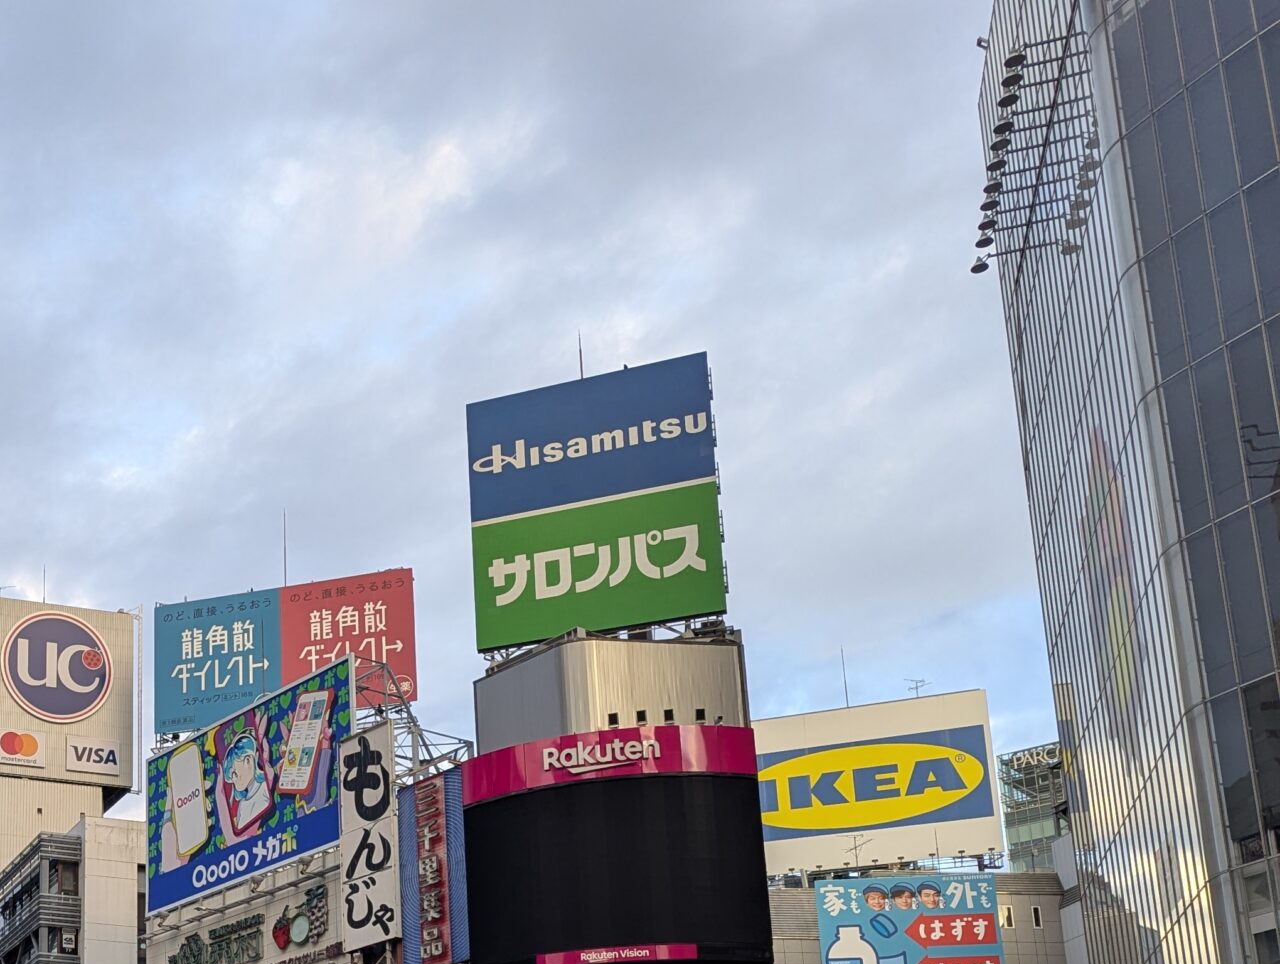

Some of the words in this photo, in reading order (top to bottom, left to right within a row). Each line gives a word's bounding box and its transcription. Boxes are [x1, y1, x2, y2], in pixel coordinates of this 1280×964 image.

[472, 411, 708, 474] Hisamitsu
[488, 523, 707, 607] サロンパス
[290, 576, 407, 604] のど、直接、うるおう
[162, 597, 272, 624] のど、直接、うるおう
[310, 601, 388, 641] 龍角散
[181, 620, 255, 659] 龍角散
[171, 658, 270, 694] ダイレクト
[182, 694, 220, 707] スティック
[0, 756, 37, 765] mastercard
[70, 744, 118, 766] VISA
[542, 738, 661, 774] Rakuten
[176, 788, 200, 809] Qoo10
[760, 756, 969, 813] IKEA
[342, 736, 396, 936] もんじゃ
[192, 851, 250, 889] Qoo10
[253, 826, 299, 868] メガポ
[415, 781, 443, 960] 三千里薬品
[820, 884, 862, 917] 家でも
[946, 881, 992, 909] 外でも
[919, 917, 989, 942] はずす
[580, 950, 619, 963] Rakuten
[620, 948, 650, 958] Vision
